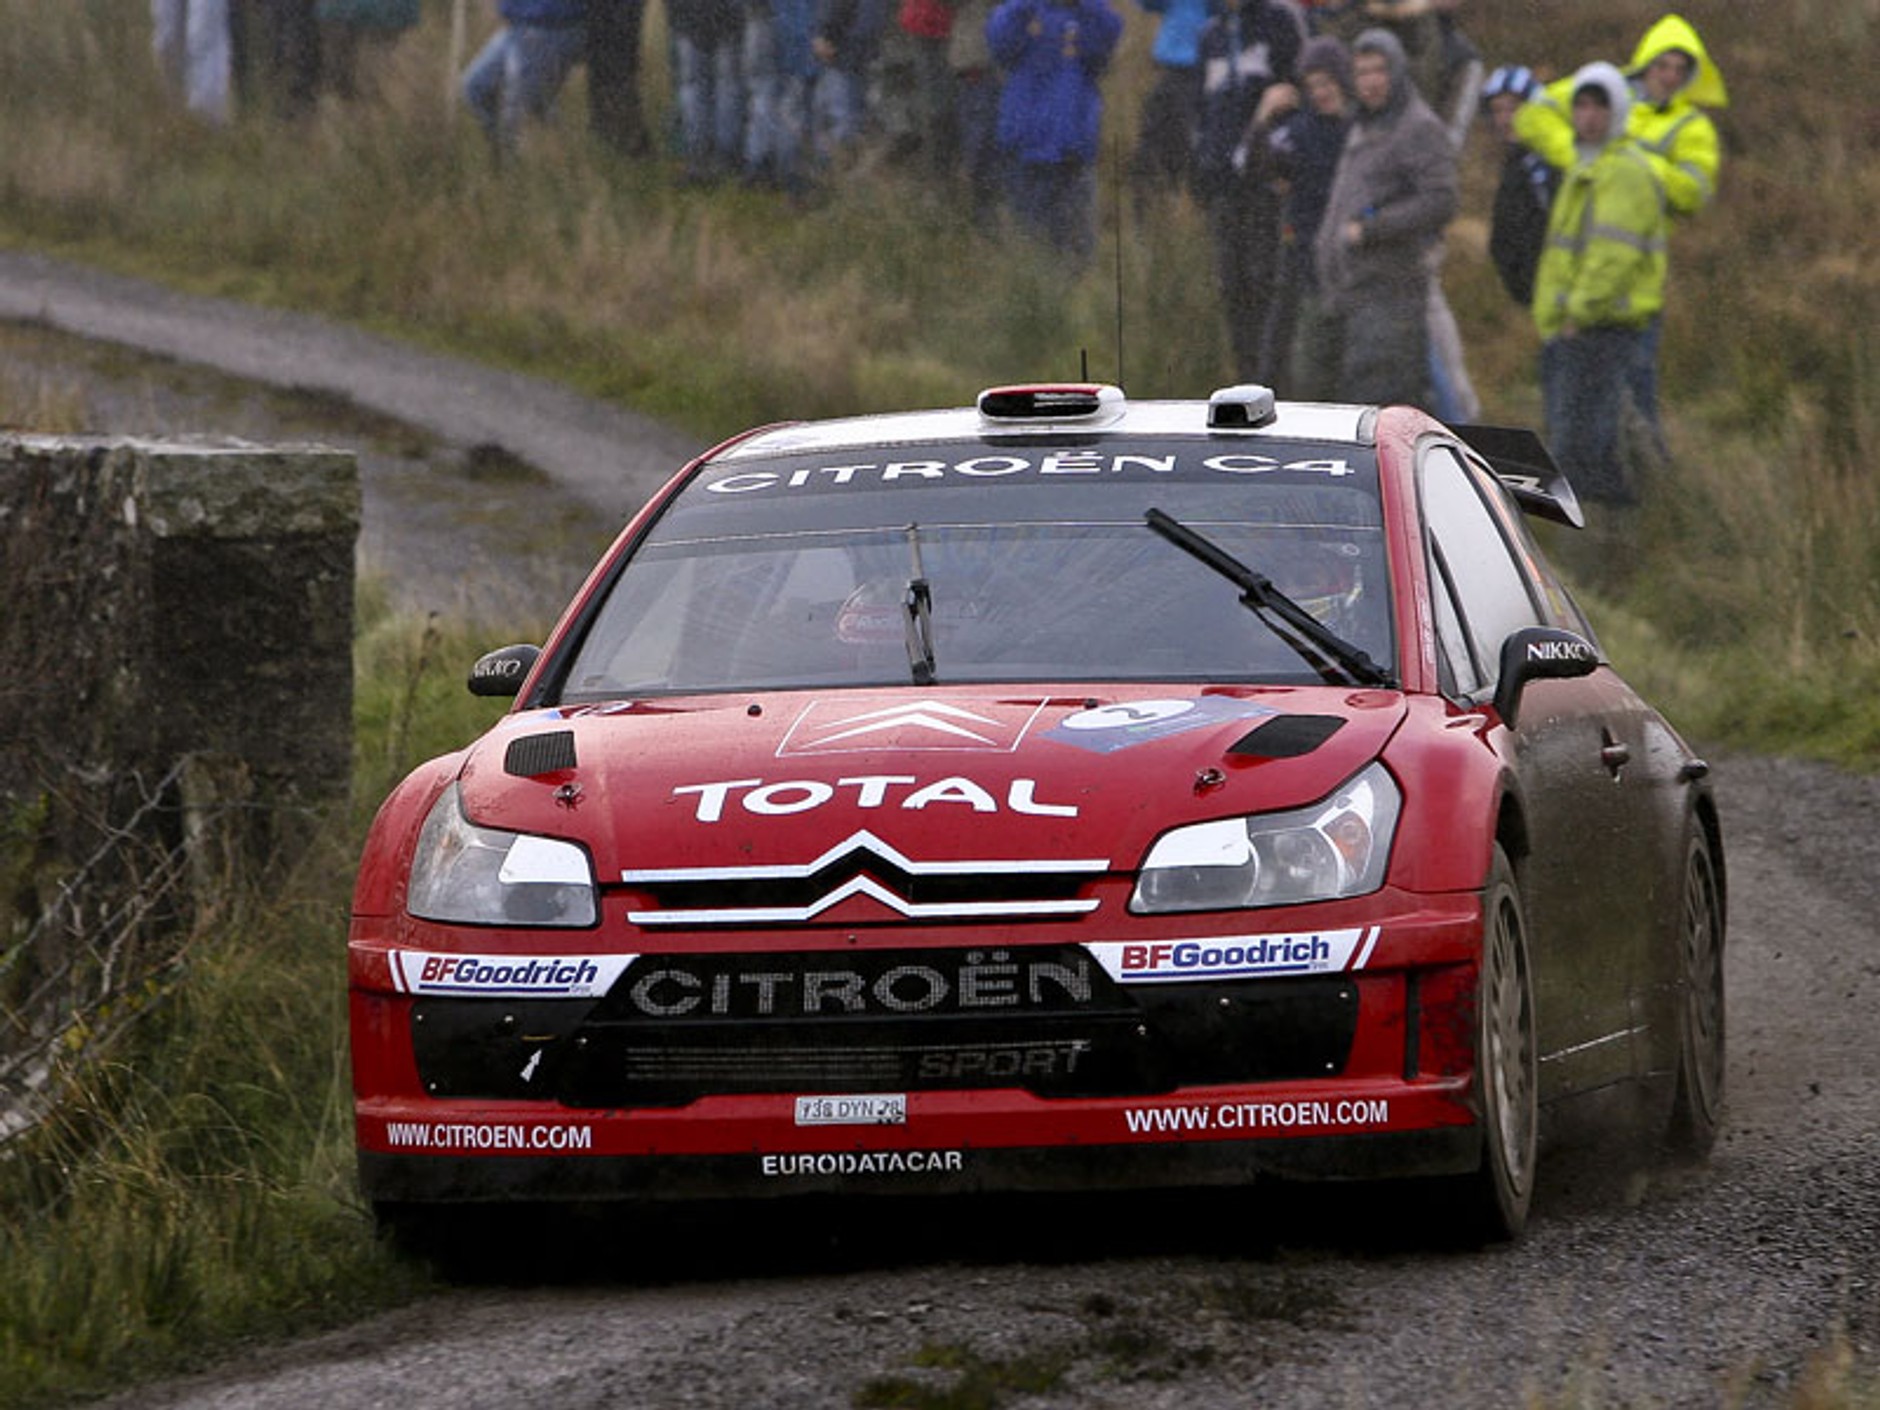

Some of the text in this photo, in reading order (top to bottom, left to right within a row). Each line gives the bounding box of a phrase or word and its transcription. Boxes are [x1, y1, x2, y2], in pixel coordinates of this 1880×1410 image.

[706, 451, 1355, 493] CITROËN C4
[673, 776, 1078, 822] TOTAL
[1121, 936, 1330, 969] BFGoodrich
[420, 957, 598, 984] BFGoodrich
[630, 951, 1092, 1016] CITROËN
[918, 1042, 1092, 1078] SPORT
[838, 1101, 874, 1117] DYN
[1125, 1100, 1388, 1133] WWW.CITROEN.COM
[387, 1123, 592, 1148] WWW.CITROEN.COM
[761, 1151, 963, 1176] EURODATACAR
